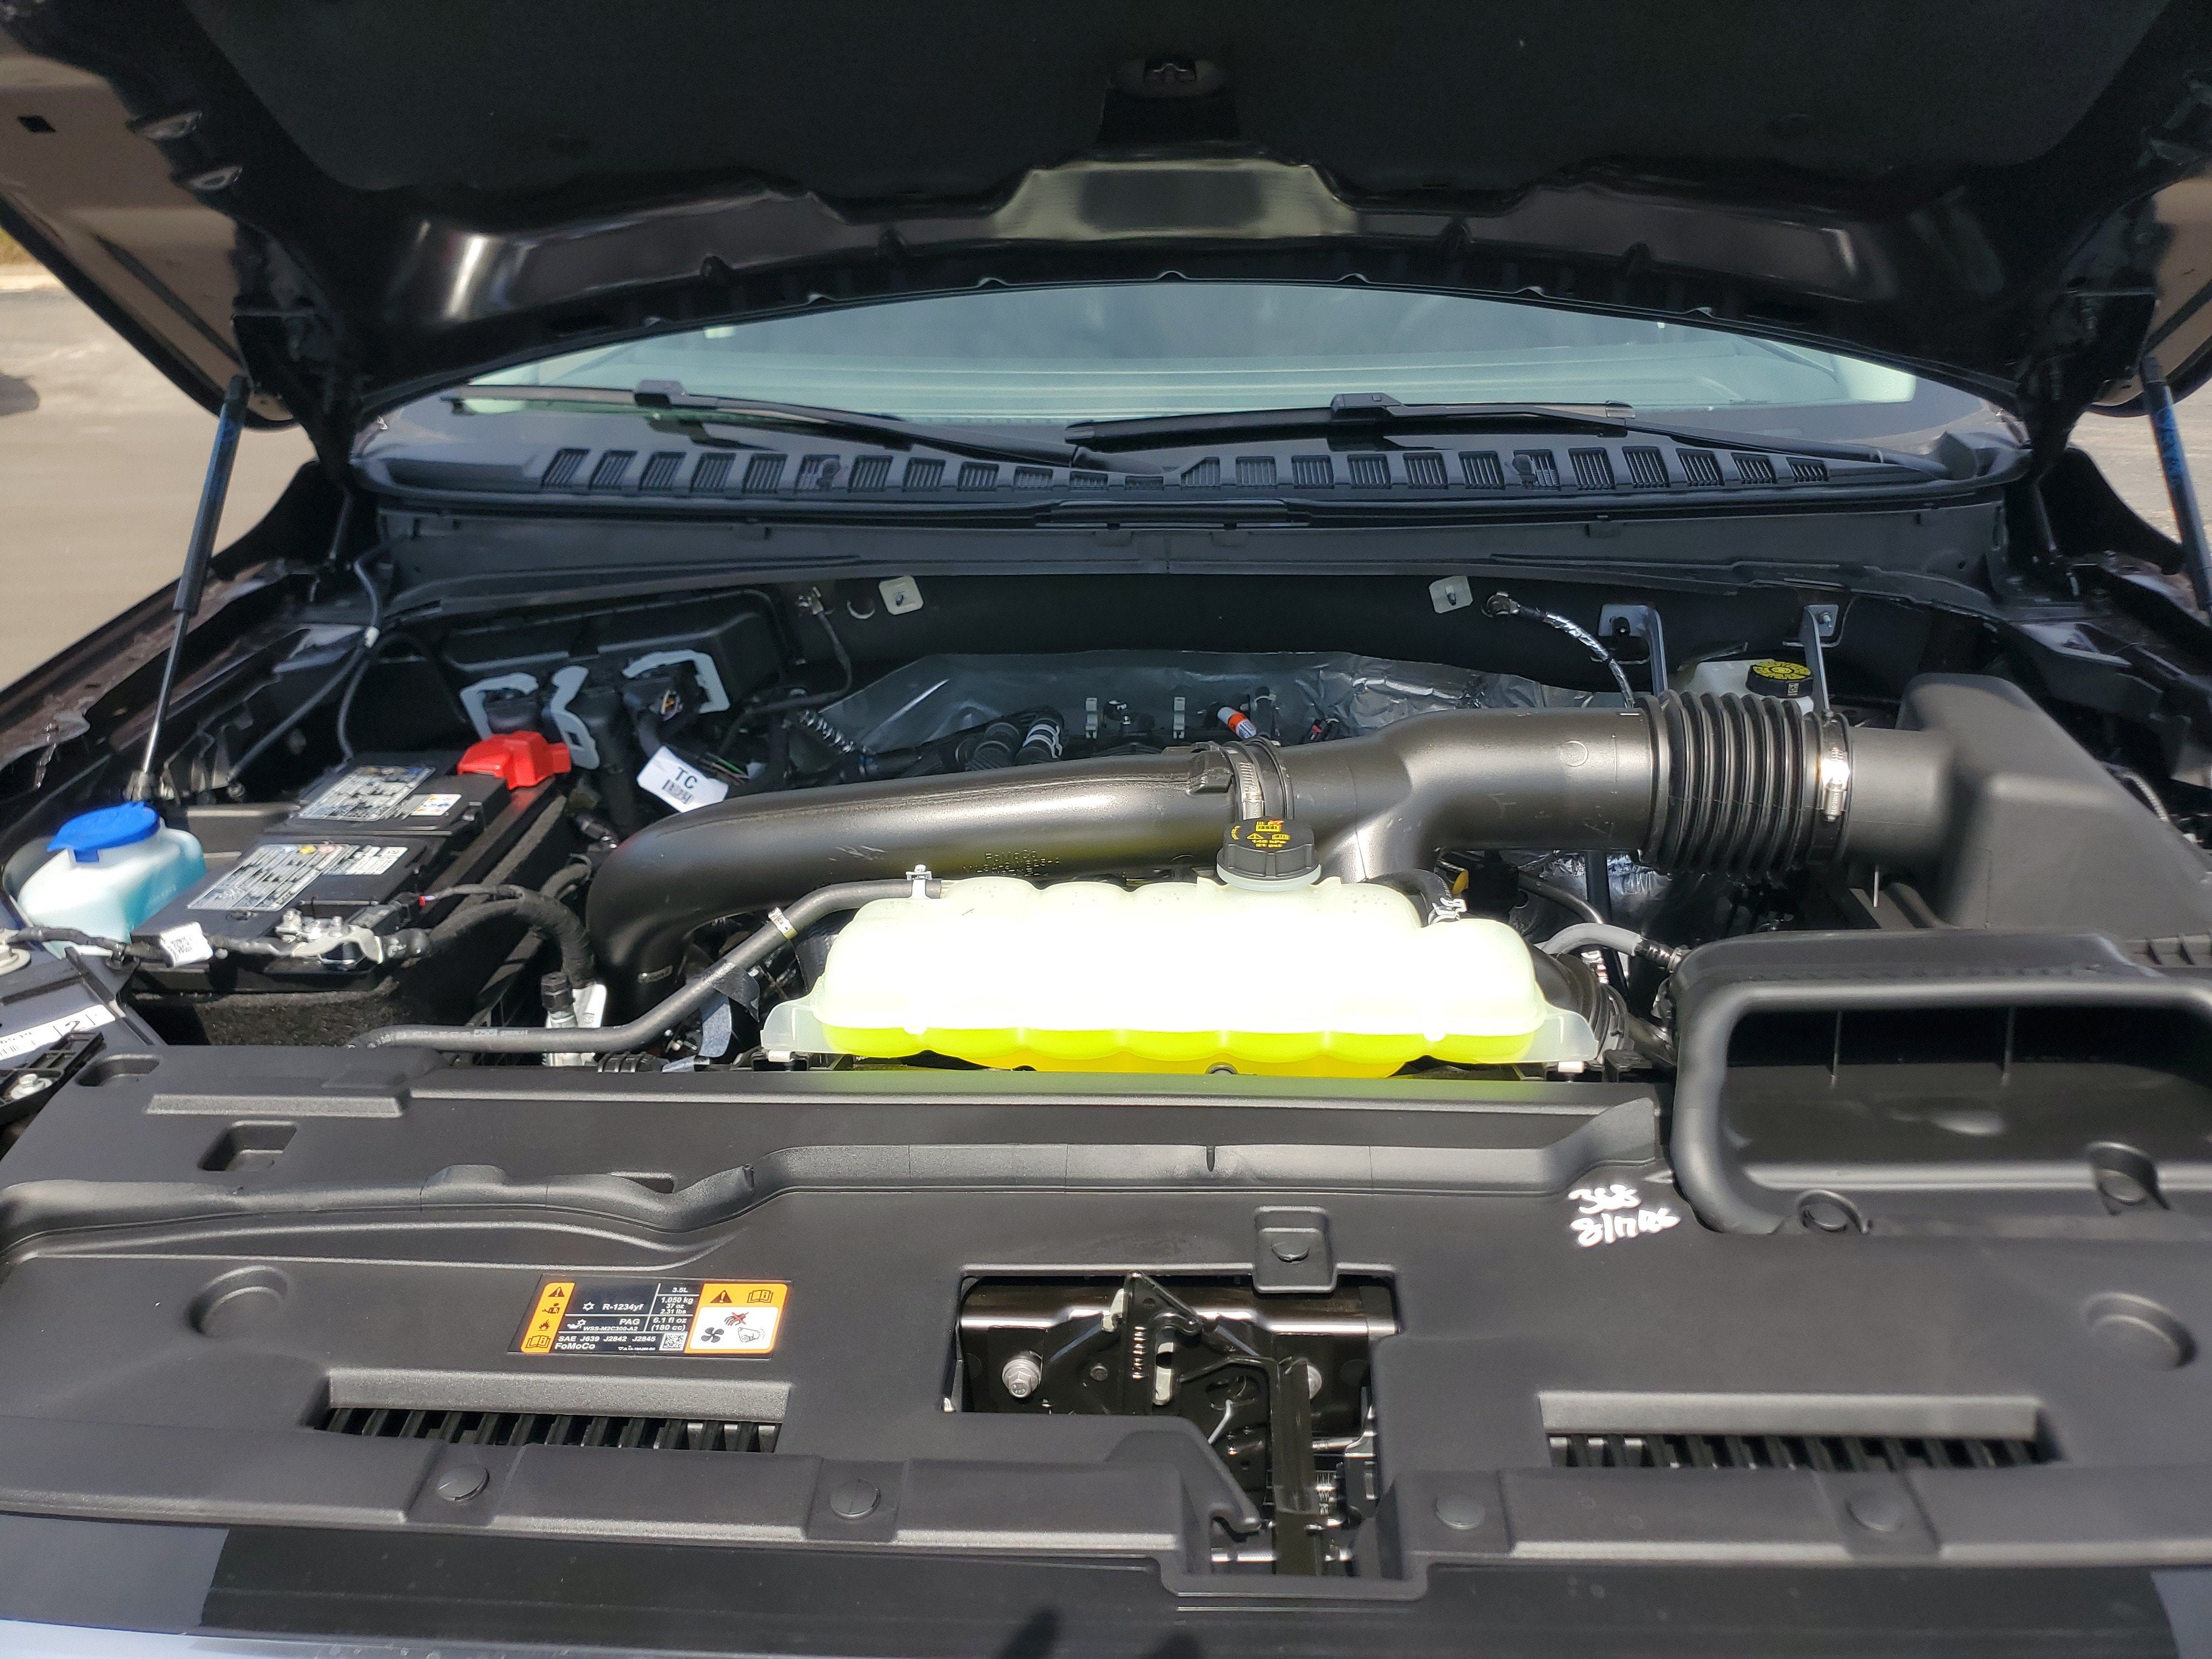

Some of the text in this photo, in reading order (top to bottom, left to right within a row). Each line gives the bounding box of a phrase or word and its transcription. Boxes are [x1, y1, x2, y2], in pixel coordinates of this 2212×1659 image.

[675, 766, 697, 789] TC
[683, 1296, 694, 1305] kg
[602, 1304, 645, 1312] R-1234yf
[554, 1342, 596, 1350] FoMoCo
